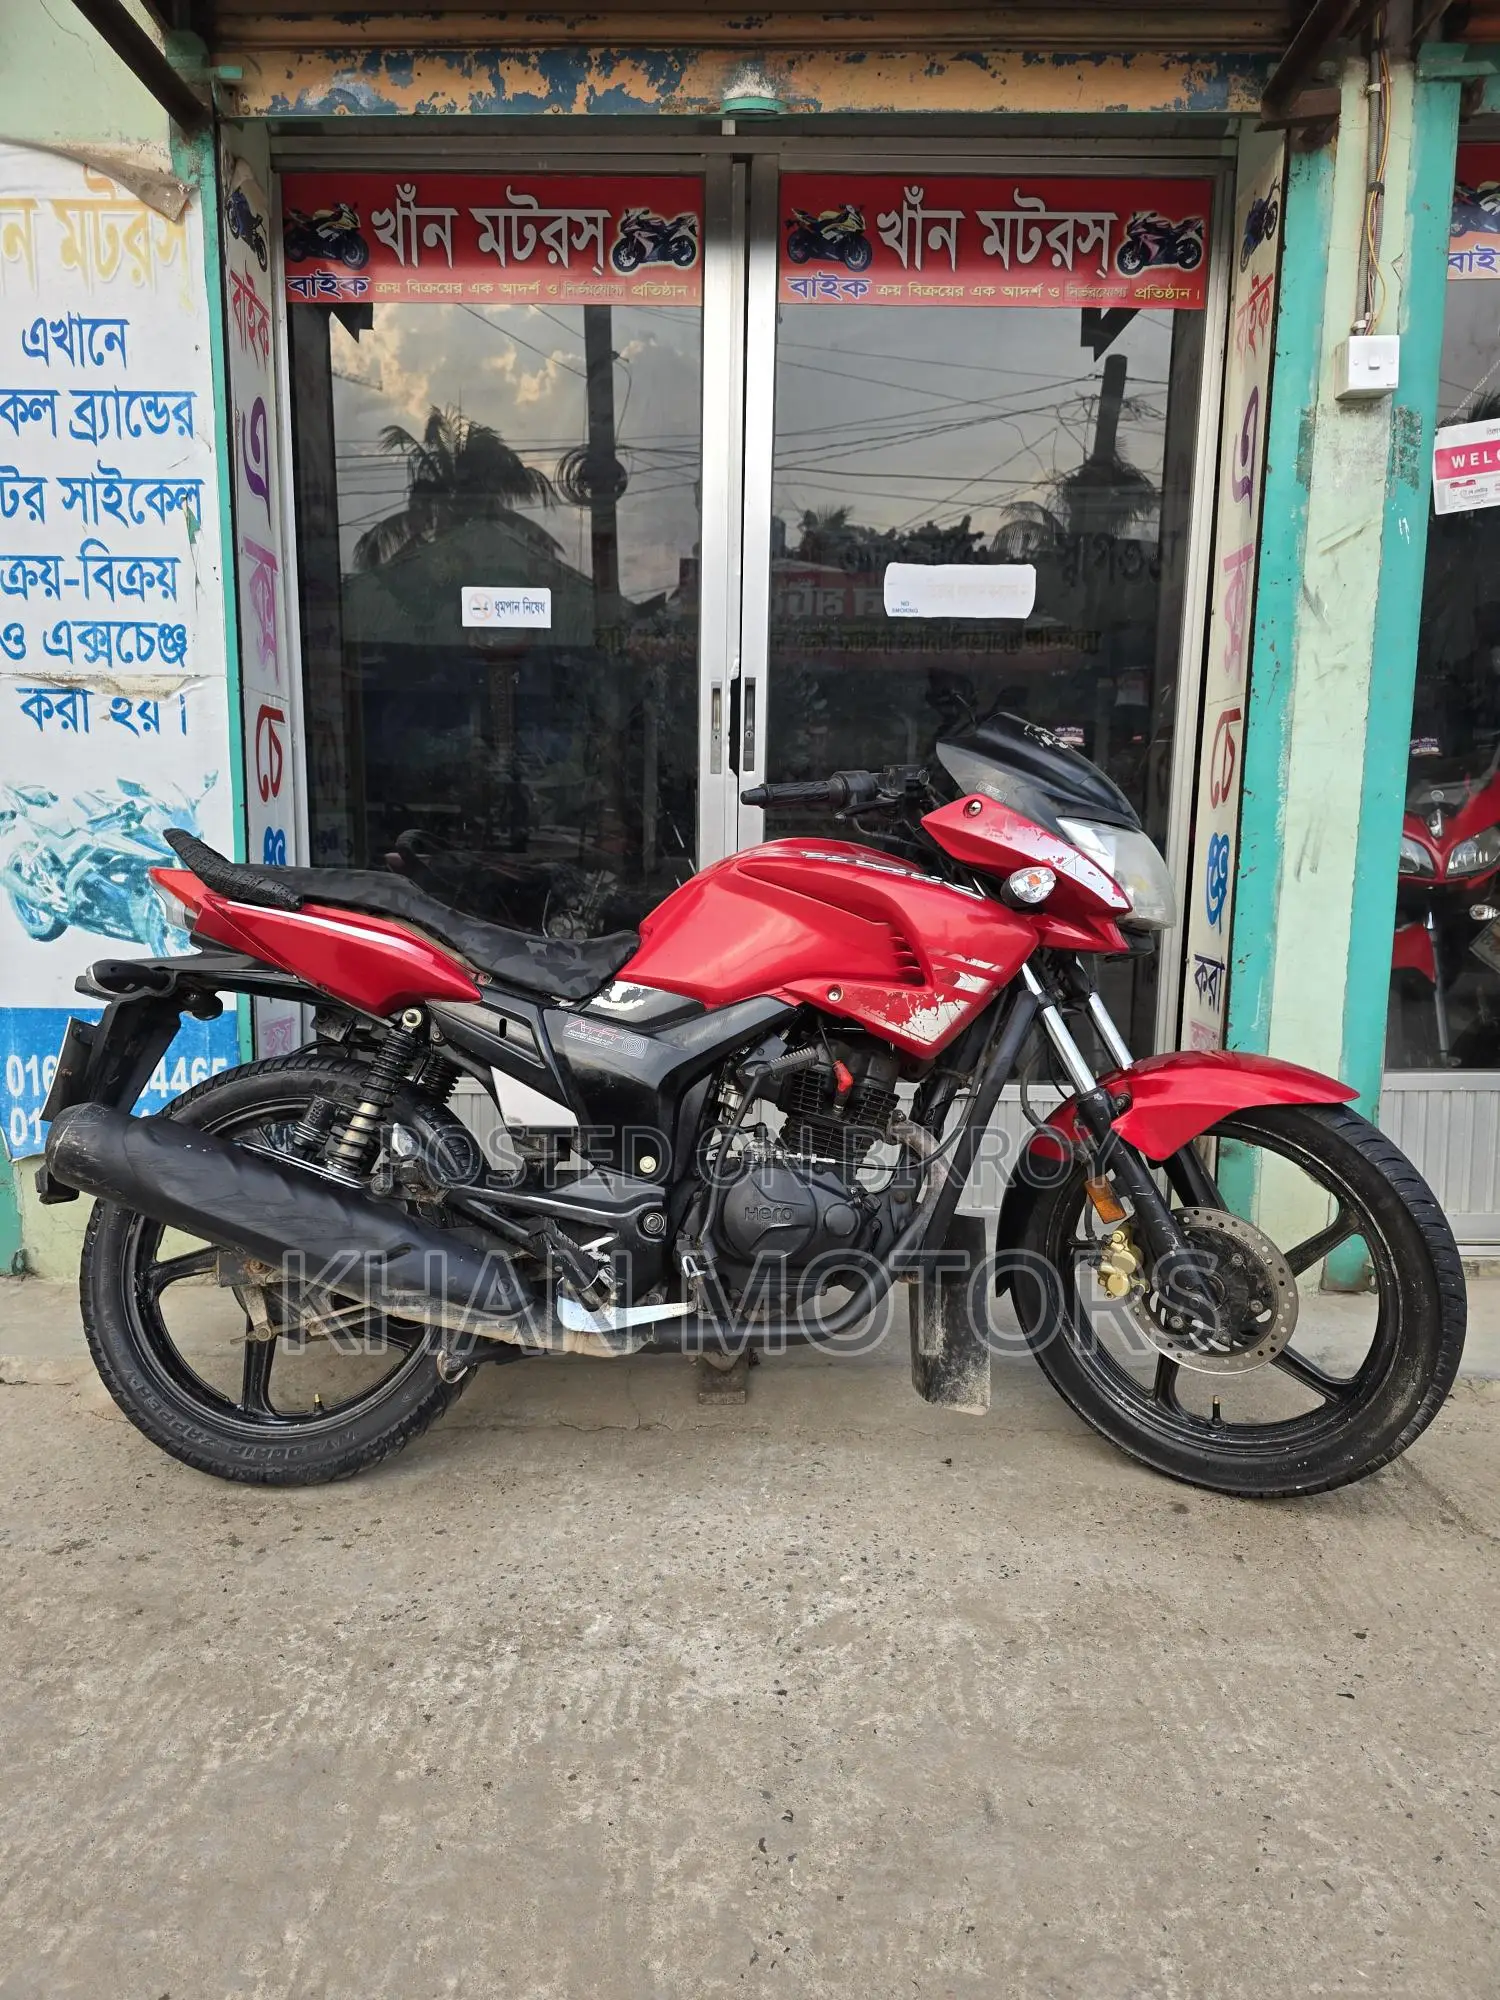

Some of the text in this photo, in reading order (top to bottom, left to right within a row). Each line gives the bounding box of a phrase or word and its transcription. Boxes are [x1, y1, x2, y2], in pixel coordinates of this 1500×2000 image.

[468, 184, 612, 276] মটরস্
[975, 187, 1119, 278] মটরস্
[1448, 245, 1500, 273] বাই
[286, 269, 371, 299] বাইক
[468, 282, 493, 294] এক
[785, 271, 871, 301] বাইক
[969, 284, 995, 297] এক
[22, 312, 130, 369] এখানে
[0, 389, 60, 438] কল
[1451, 449, 1500, 469] WEL
[0, 459, 205, 528] টর সাইকেল
[0, 620, 188, 668] ও এক্সচেঞ্জ
[15, 687, 95, 735] করা
[744, 1205, 794, 1222] Hero
